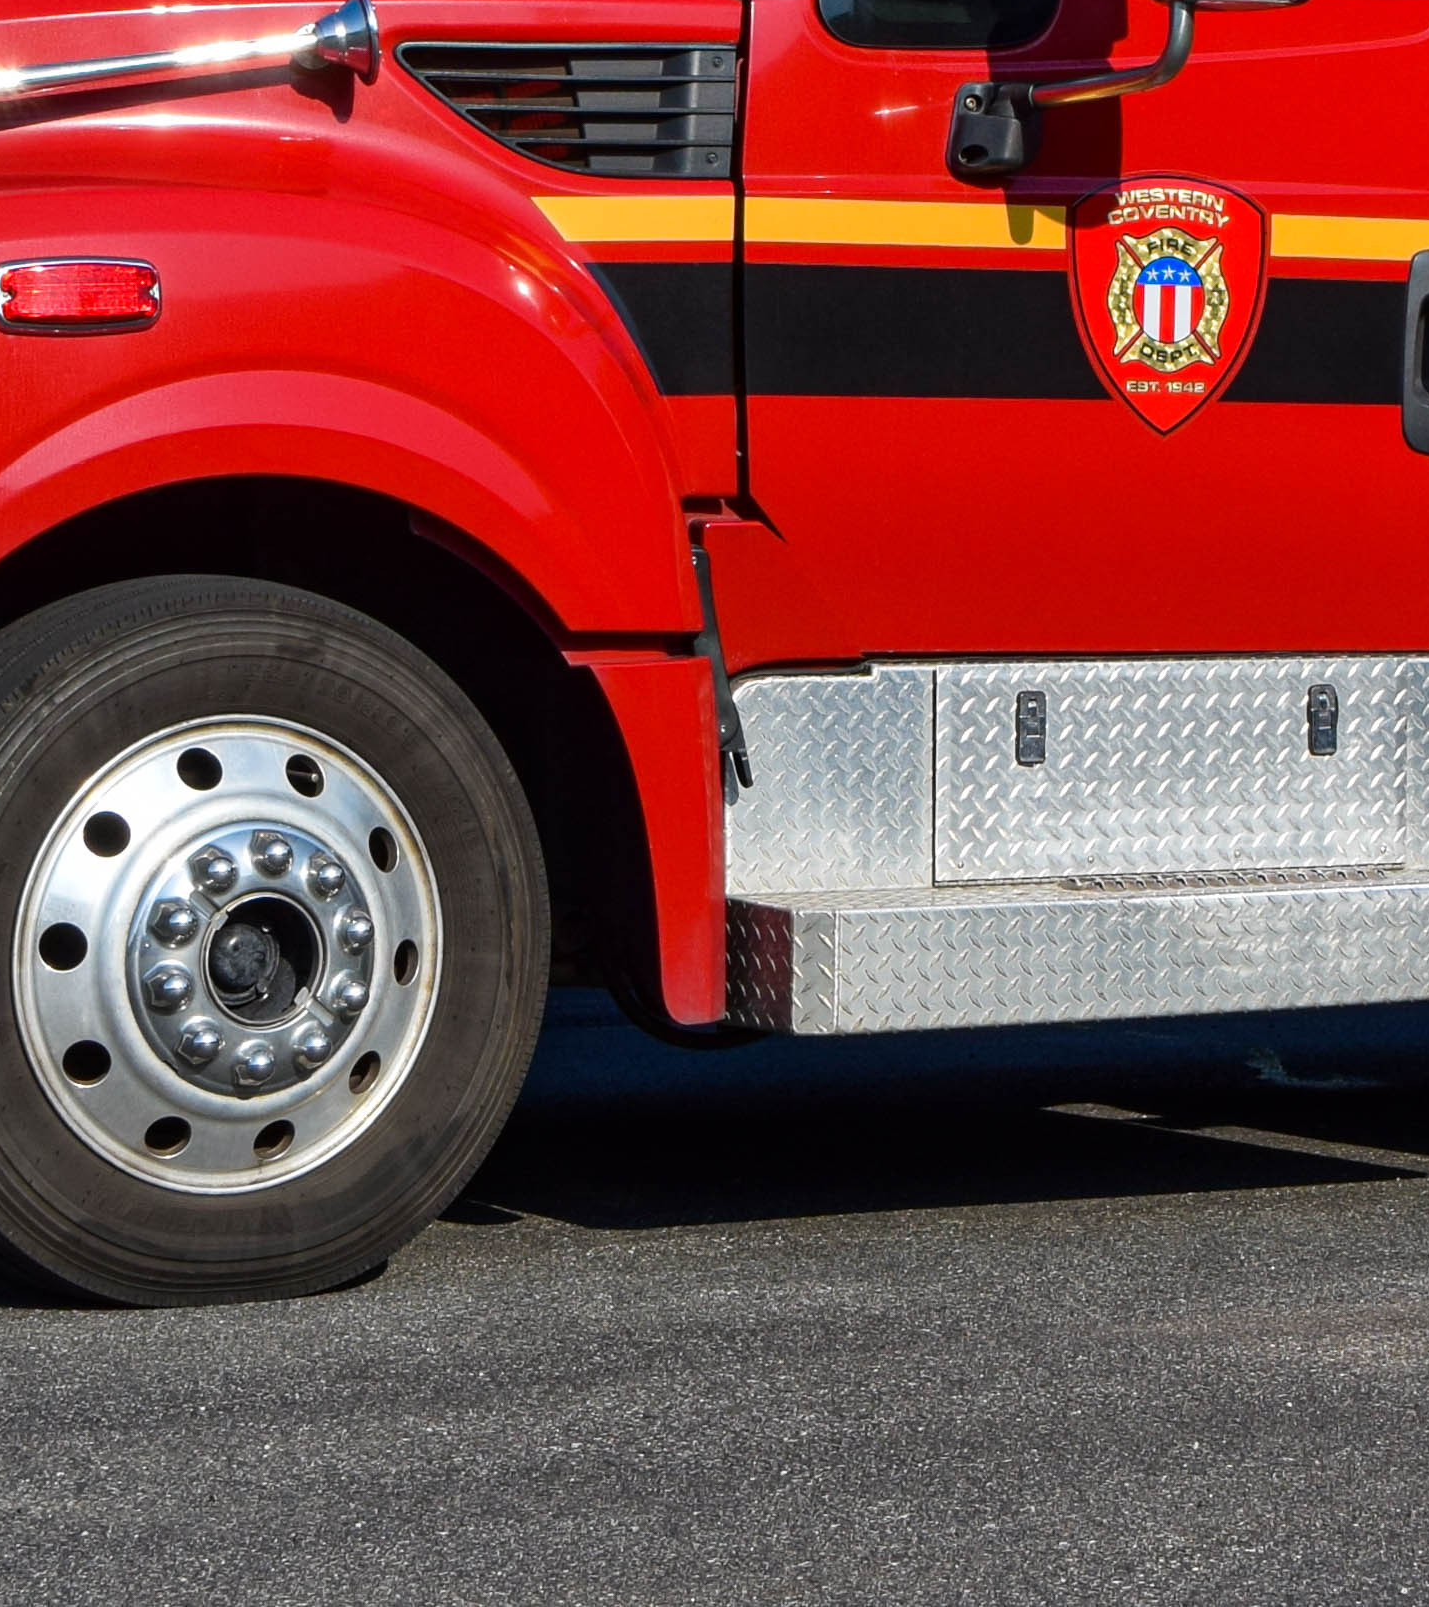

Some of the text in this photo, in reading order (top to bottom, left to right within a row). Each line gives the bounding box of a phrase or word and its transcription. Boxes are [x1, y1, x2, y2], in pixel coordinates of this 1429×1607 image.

[1115, 187, 1224, 211] WESTERN
[1107, 205, 1230, 228] COVENTRY
[1147, 240, 1194, 257] FIRE
[1126, 380, 1205, 393] EST. 1942
